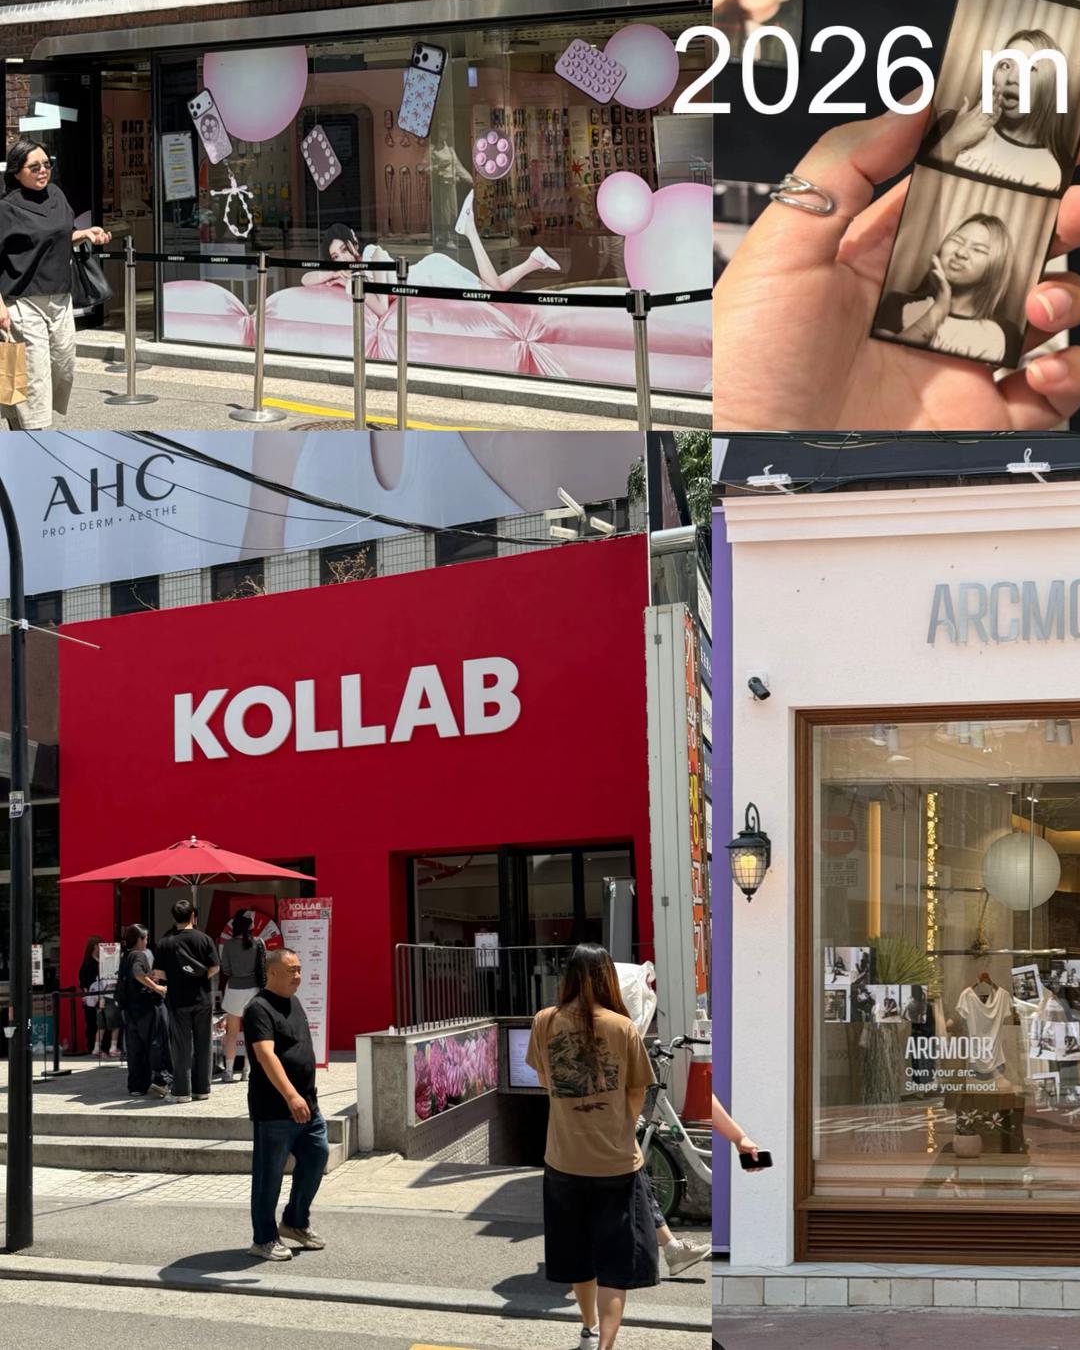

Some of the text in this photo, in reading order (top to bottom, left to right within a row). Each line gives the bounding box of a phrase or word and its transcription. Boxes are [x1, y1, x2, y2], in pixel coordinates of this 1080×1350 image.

[43, 453, 176, 522] AHC
[42, 505, 178, 538] PRO DERM AESTHE
[174, 656, 521, 763] KOLLAB
[905, 1036, 993, 1060] ARCMOOR
[905, 1068, 976, 1081] Own your arc.
[905, 1081, 999, 1094] Shape your mood.
